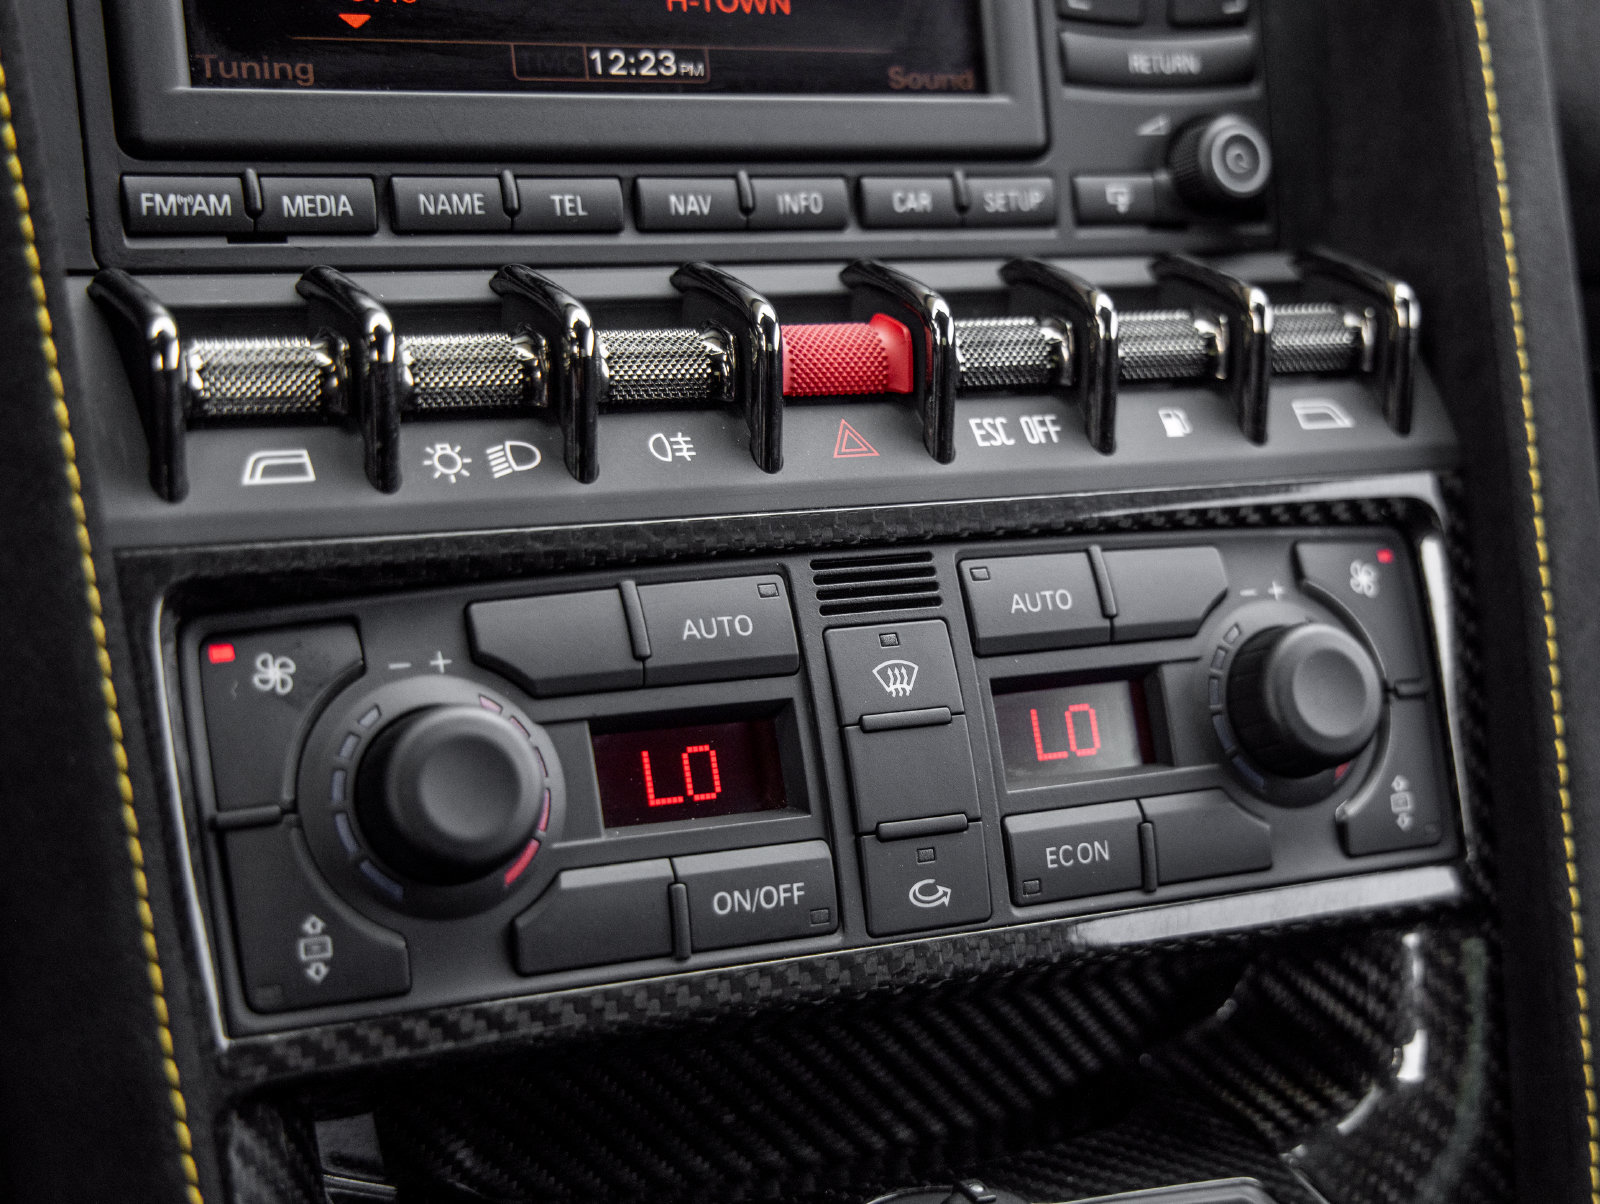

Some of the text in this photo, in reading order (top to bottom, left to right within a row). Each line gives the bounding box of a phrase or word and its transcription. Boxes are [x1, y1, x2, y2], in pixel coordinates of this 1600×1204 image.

[195, 54, 315, 87] Tuning
[589, 49, 705, 77] 12:23 PM
[1128, 53, 1202, 75] RETURN
[888, 65, 975, 91] Sound
[281, 194, 354, 218] MEDIA
[418, 192, 486, 216] NAME
[550, 194, 588, 217] TEL
[668, 193, 712, 217] NAV
[776, 191, 823, 215] INFO
[892, 190, 933, 214] CAR
[983, 189, 1045, 213] SETUP
[968, 413, 1062, 447] ESC OFF
[1010, 588, 1073, 614] AUTO
[682, 614, 754, 641] AUTO
[1030, 702, 1101, 762] LO
[641, 744, 722, 807] LO
[1045, 839, 1110, 869] ECON
[713, 882, 806, 915] ON/OFF
